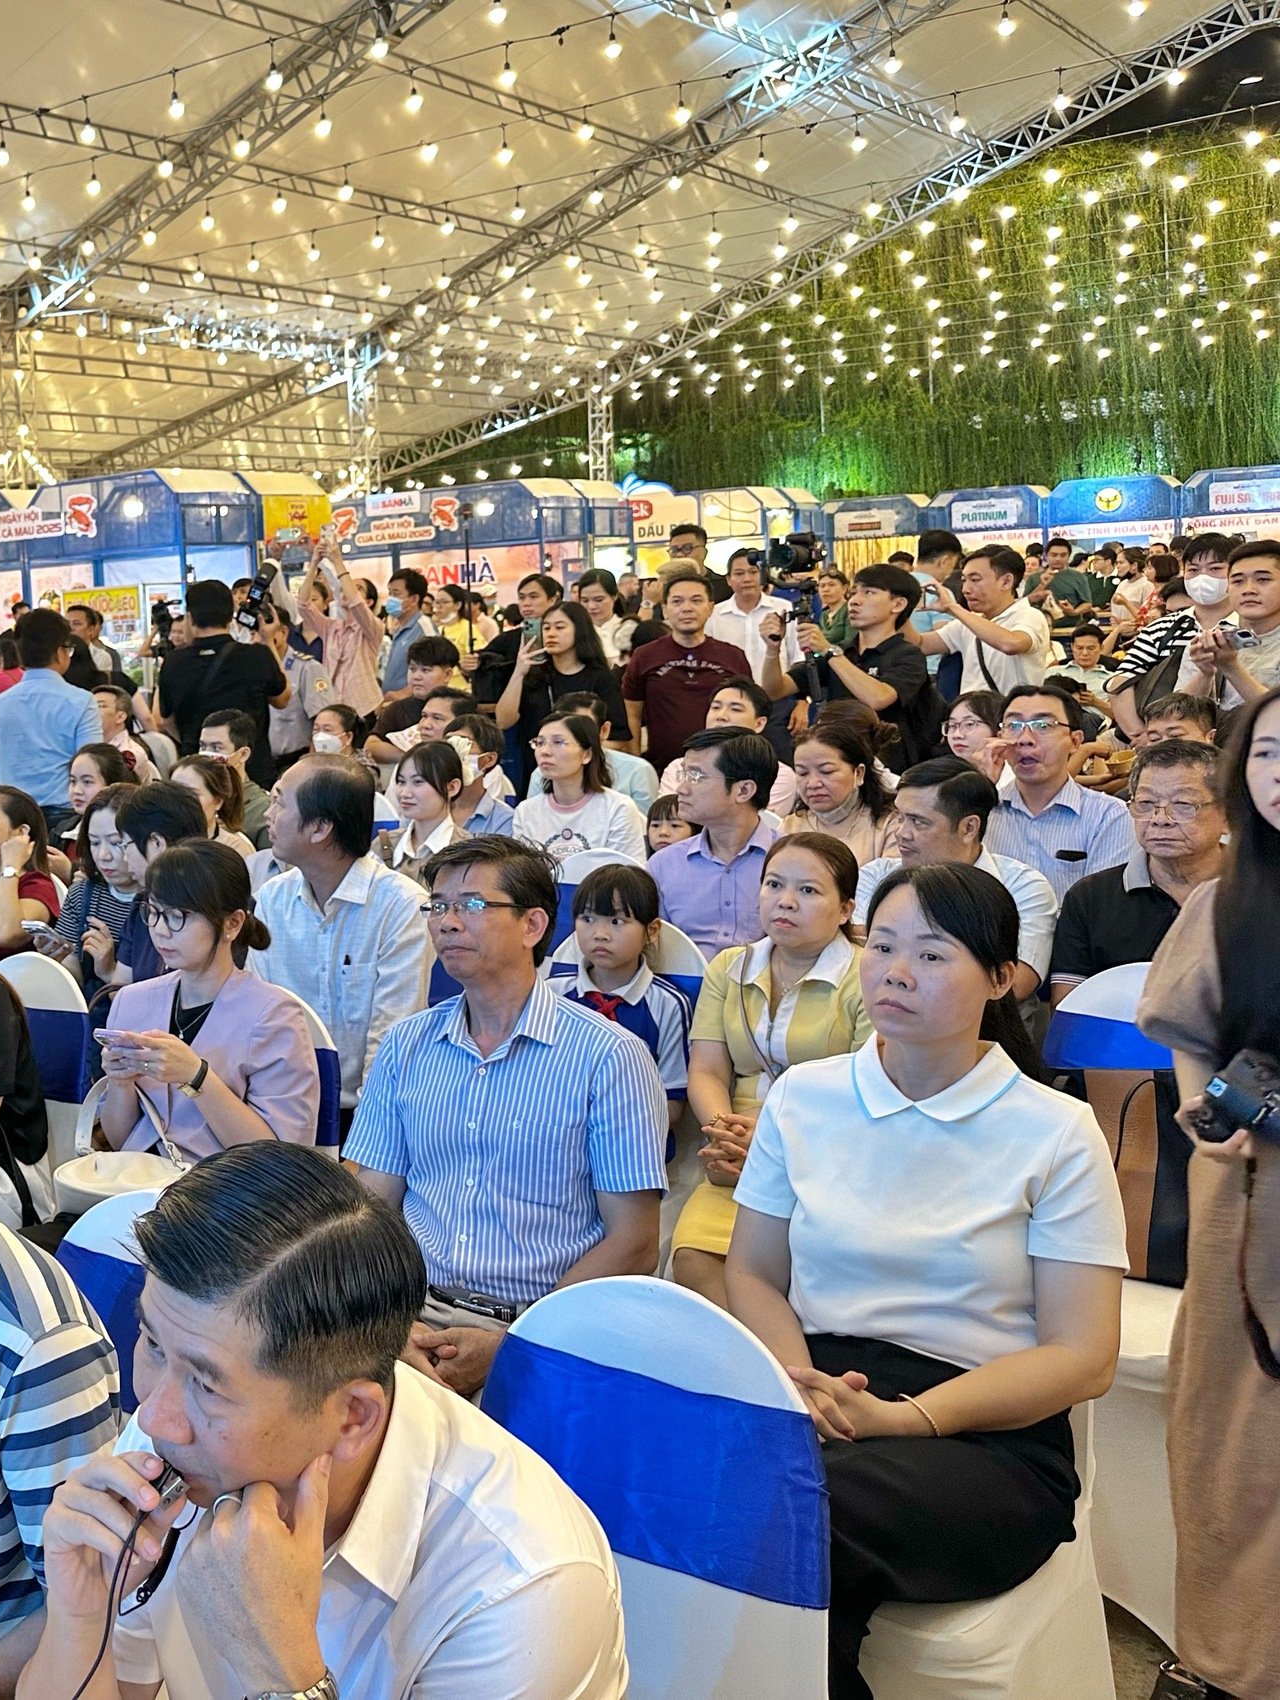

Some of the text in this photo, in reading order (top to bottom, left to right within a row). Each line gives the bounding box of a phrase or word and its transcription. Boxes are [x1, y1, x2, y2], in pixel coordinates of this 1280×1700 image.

[0, 509, 39, 525] NGÀY HỘI
[373, 518, 412, 531] NGÀY HỘI
[961, 510, 1008, 523] PLATINUM
[2, 526, 13, 538] CÀ
[15, 525, 35, 537] MAU
[37, 522, 61, 535] 2025
[357, 528, 432, 544] CUA CÀ MAU 2025
[417, 556, 495, 585] ANHÀ
